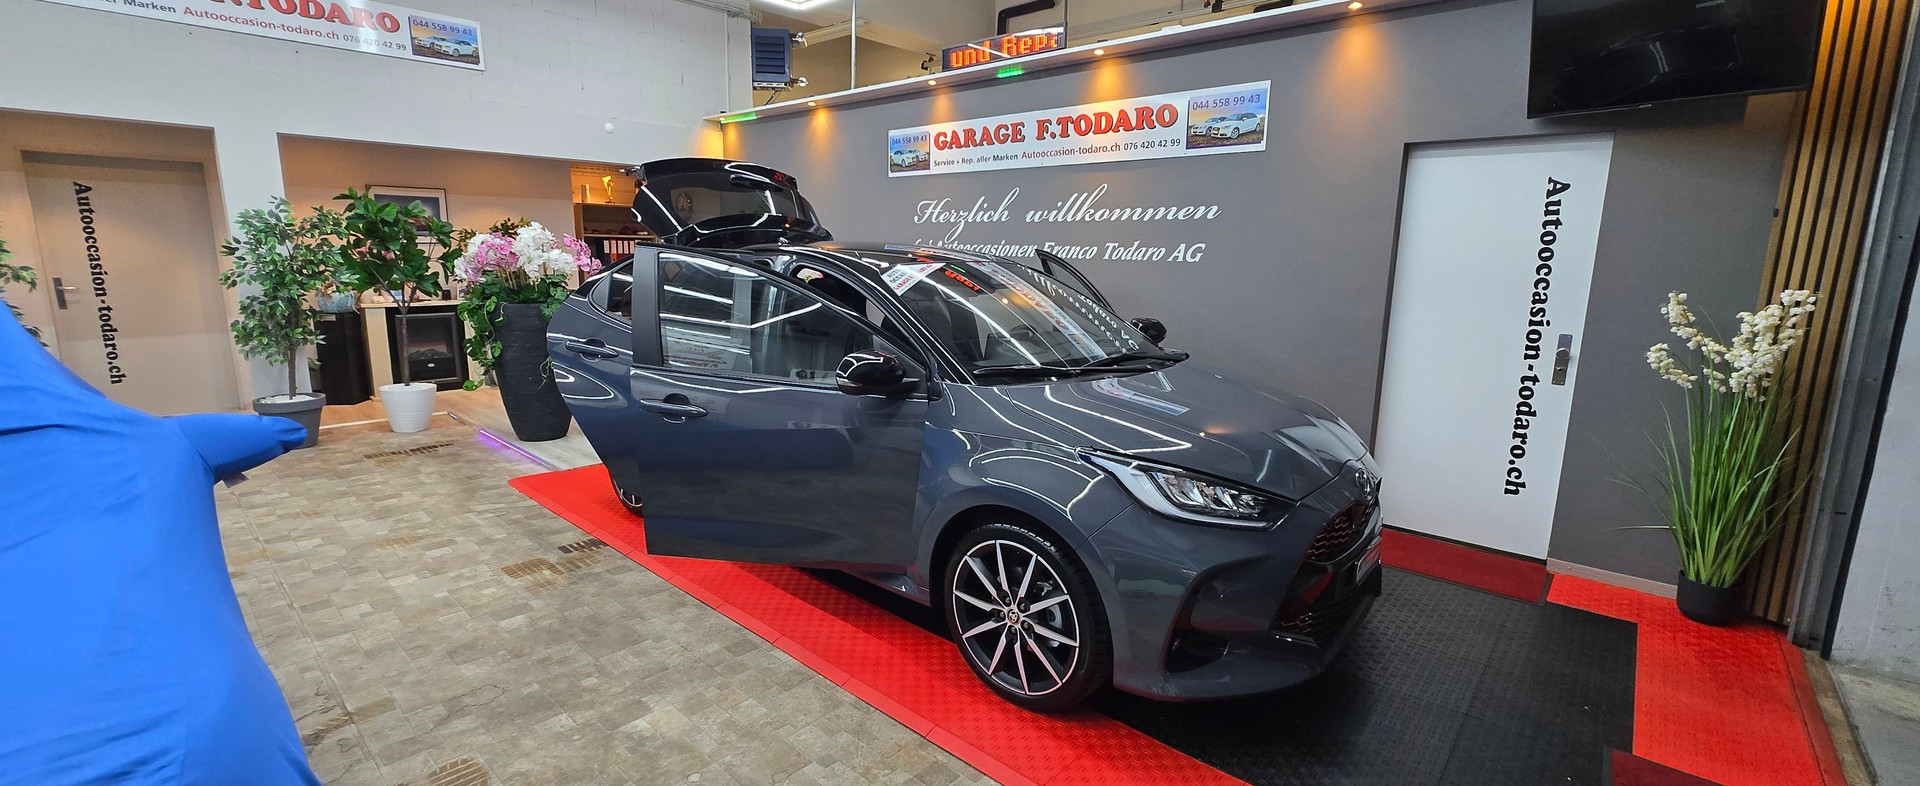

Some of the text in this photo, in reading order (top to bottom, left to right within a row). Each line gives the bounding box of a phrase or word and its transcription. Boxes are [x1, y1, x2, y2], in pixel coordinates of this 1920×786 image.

[124, 0, 407, 51] Marken Autooccasion-todaro.ch 076 420 42 99
[210, 0, 401, 33] .ODARO
[413, 19, 473, 37] 044 558 99 43
[949, 40, 992, 68] und
[1192, 93, 1261, 111] 044 558 99 43
[892, 134, 928, 146] 044 558 99 43
[933, 103, 1179, 151] GARAGE F.TODARO
[961, 157, 974, 165] Rep.
[976, 155, 991, 163] aller
[992, 153, 1019, 162] Marken
[1021, 141, 1121, 160] Autooccasion-todaro.ch
[1123, 141, 1139, 151] 076
[1140, 140, 1156, 150] 420
[1157, 139, 1168, 149] 42
[1170, 138, 1181, 147] 99
[913, 183, 1222, 243] Herzlich willkommen
[1043, 241, 1098, 260] Franco
[1103, 240, 1163, 262] Todaro
[1167, 243, 1207, 263] AG
[73, 181, 127, 385] Autooccasion-todaro.ch
[1504, 176, 1571, 496] Autooccasion-todaro.ch
